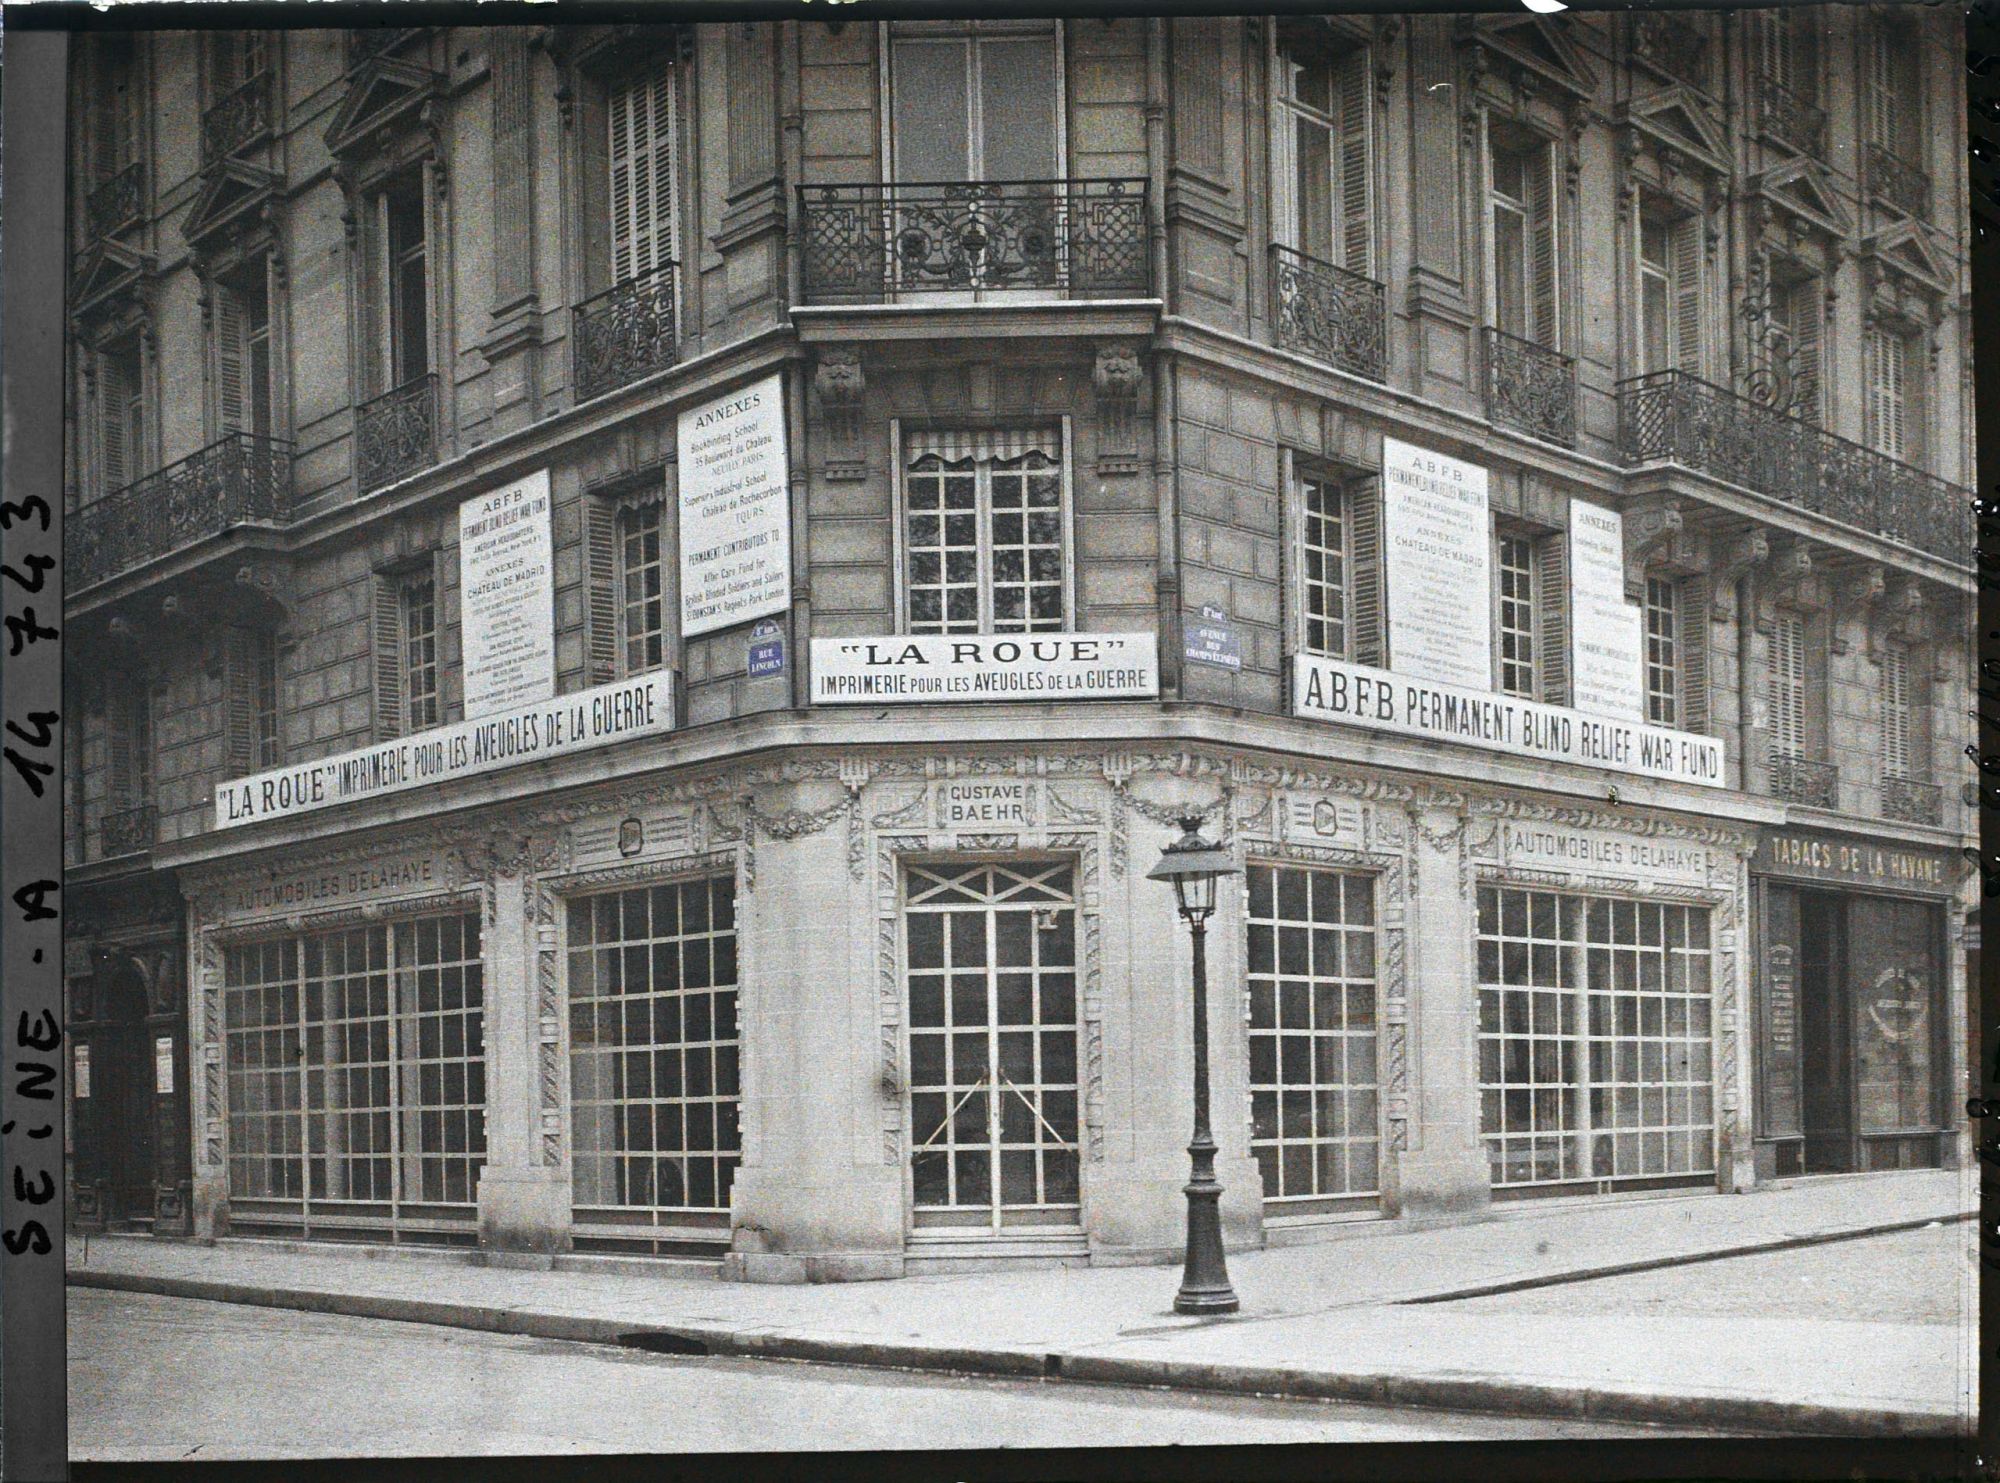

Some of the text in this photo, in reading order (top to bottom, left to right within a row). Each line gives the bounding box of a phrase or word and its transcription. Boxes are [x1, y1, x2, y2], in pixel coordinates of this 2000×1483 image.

[696, 394, 761, 430] ANNEXES
[734, 418, 757, 438] School
[704, 444, 732, 465] Boulevard
[714, 478, 741, 498] Industrial
[745, 470, 765, 487] School
[729, 497, 736, 509] de
[735, 504, 763, 525] TOURS
[688, 528, 779, 567] PERMANENT CONTRIBUTORS TO
[503, 574, 512, 587] DE
[515, 563, 544, 583] MADRID
[721, 565, 735, 579] Care
[738, 559, 753, 574] Fund
[749, 591, 761, 604] Park
[759, 648, 774, 659] RUE
[751, 659, 781, 673] LINCOLN
[821, 669, 1147, 695] IMPRIMERIE POUR LES AVEUGLES DE LA GUERRE
[338, 745, 408, 797] IMPRIMERIE
[414, 741, 443, 778] POUR
[449, 735, 467, 770] LES
[474, 713, 538, 765] AVEUGLES
[546, 711, 562, 748] DE
[570, 706, 585, 742] LA
[593, 684, 654, 737] GUERRE
[1407, 687, 1514, 743] PERMANENT
[1524, 710, 1571, 754] BLIND
[1582, 721, 1630, 764] RELIEF
[1639, 733, 1673, 772] WAR
[1682, 741, 1718, 779] FUND
[951, 785, 1022, 801] GUSTAVE
[952, 804, 1025, 822] BAEHR
[1514, 831, 1701, 873] AUTOMOBILES DELAHAYE
[1772, 837, 1941, 884] TABACS DE LA HAVANE
[237, 860, 432, 911] AUTOMOBILES DELAHAYE
